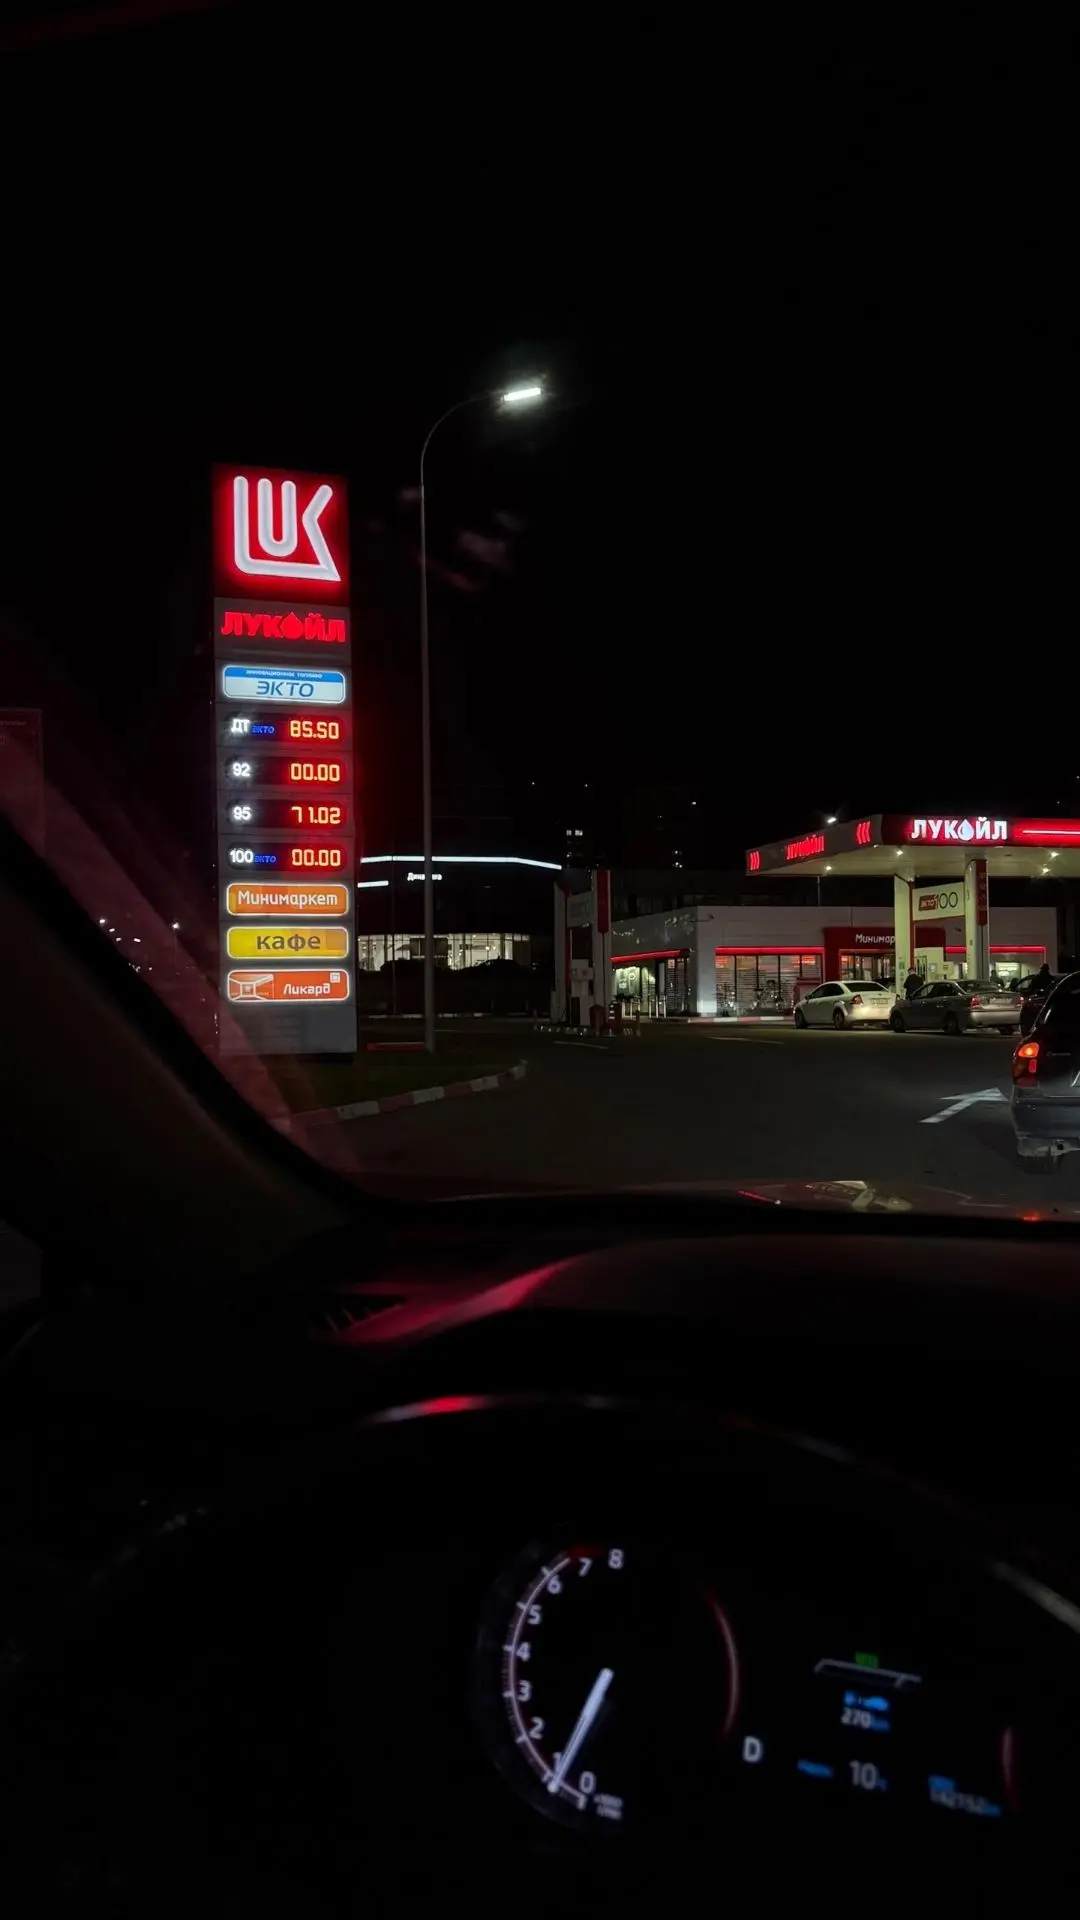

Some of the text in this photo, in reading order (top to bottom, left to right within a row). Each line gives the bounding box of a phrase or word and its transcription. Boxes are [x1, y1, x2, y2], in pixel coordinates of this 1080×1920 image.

[221, 611, 346, 643] ЛУКОЙЛ
[256, 681, 314, 697] ЭКТО
[231, 719, 250, 733] ДТ
[290, 720, 340, 739] 85.50
[232, 763, 340, 782] 92 00.00
[233, 806, 341, 824] 95 71.02
[911, 816, 1008, 841] ЛУКОЙЛ
[230, 848, 254, 863] 100
[291, 848, 341, 867] 00.00
[237, 890, 339, 910] Минимаркет
[256, 934, 321, 952] кафе
[855, 933, 896, 945] Минимар
[283, 983, 331, 996] Ликард
[578, 1557, 593, 1577] 7
[607, 1548, 625, 1570] 8
[547, 1574, 563, 1595] 6
[528, 1603, 543, 1625] 5
[515, 1641, 531, 1662] 4
[518, 1679, 532, 1702] 3
[529, 1716, 545, 1740] 2
[742, 1735, 764, 1764] D
[579, 1770, 597, 1795] 0
[848, 1759, 878, 1791] 10
